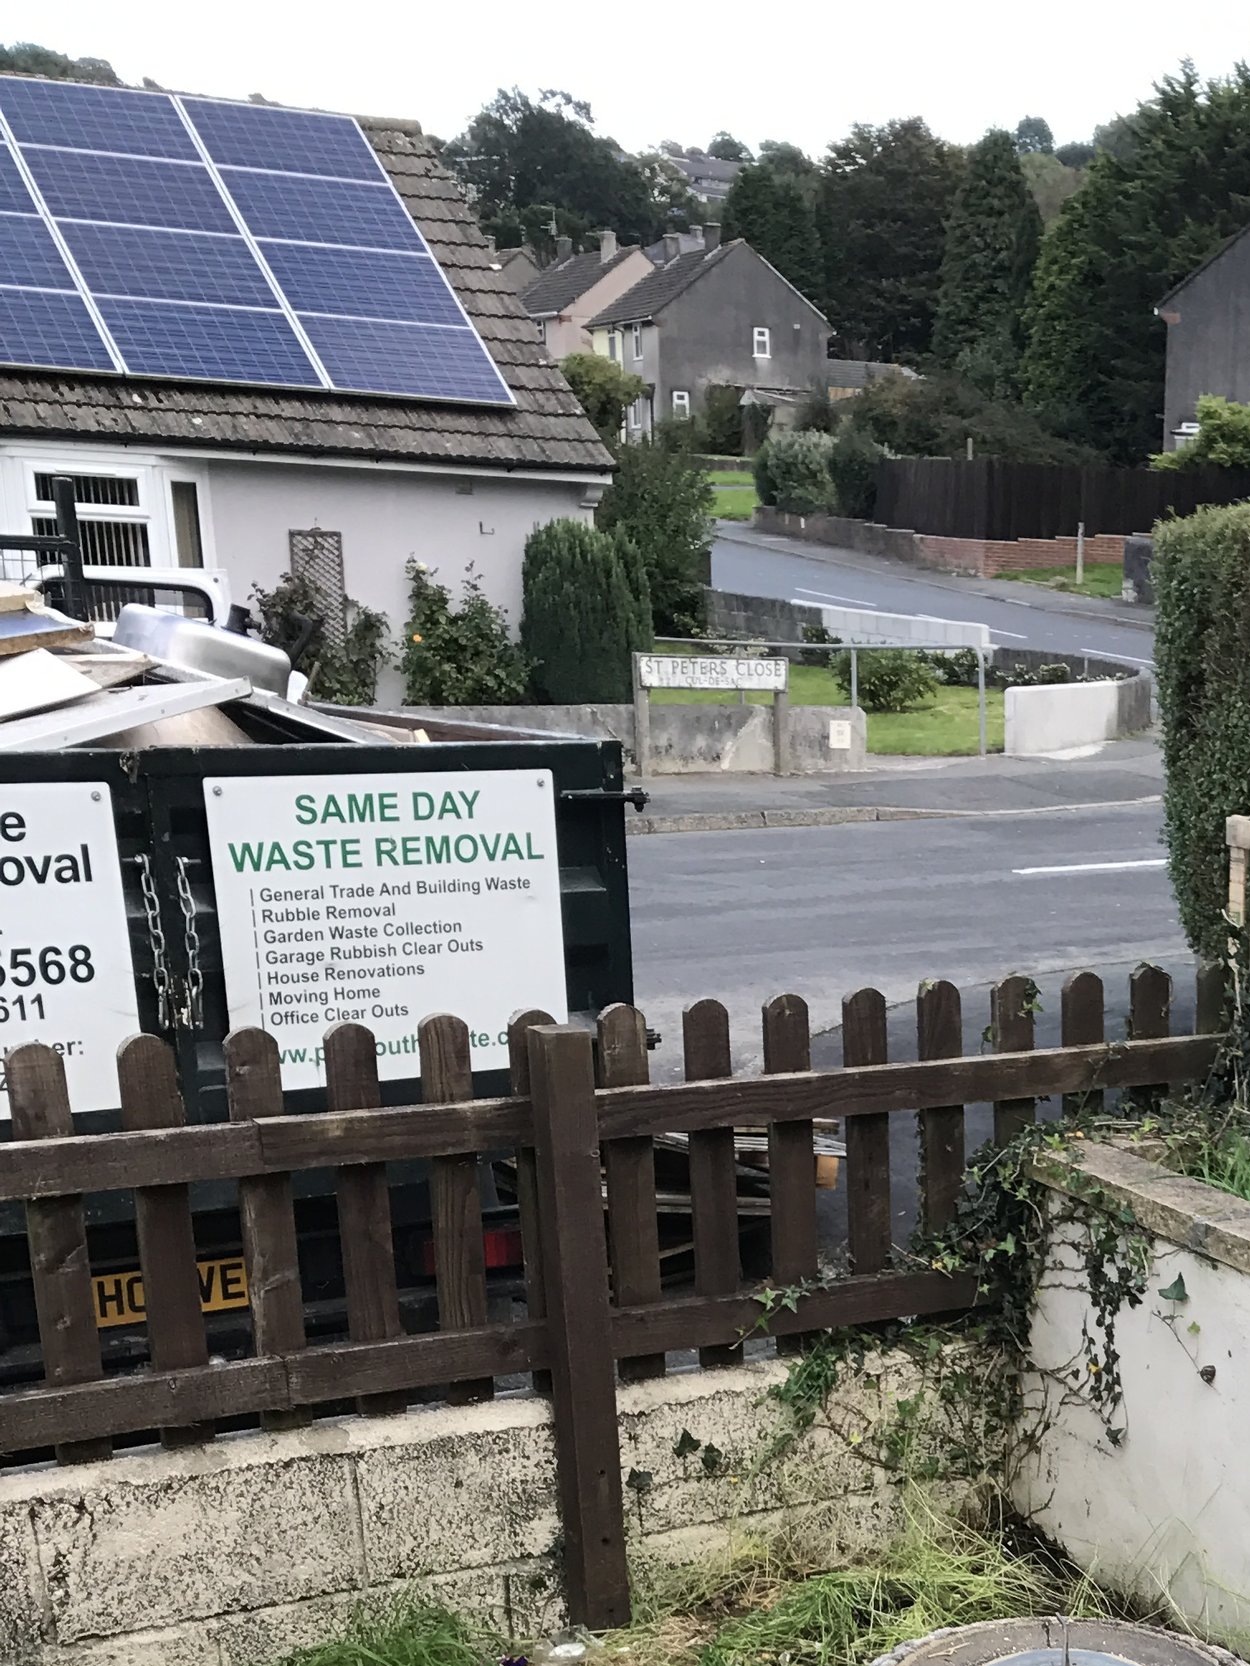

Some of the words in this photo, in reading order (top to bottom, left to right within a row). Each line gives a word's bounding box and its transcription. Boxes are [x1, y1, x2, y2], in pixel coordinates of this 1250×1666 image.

[645, 660, 663, 674] ST
[672, 660, 727, 676] PETERS
[736, 661, 782, 677] CLOSE
[295, 793, 400, 825] SAME
[412, 790, 480, 820] DAY
[228, 838, 363, 873] WASTE
[375, 832, 544, 867] REMOVAL
[260, 885, 324, 902] General
[329, 883, 375, 899] Trade
[379, 881, 411, 896] And
[416, 878, 481, 895] Building
[485, 876, 531, 891] Waste
[262, 907, 320, 923] Rubble
[326, 902, 396, 920] Removal
[264, 928, 324, 944] Garden
[329, 925, 378, 940] Waste
[383, 920, 462, 937] Collection
[265, 950, 325, 966] Garage
[330, 943, 397, 960] Rubbish
[402, 941, 443, 956] Clear
[447, 939, 483, 953] Outs
[0, 944, 95, 988] 568
[267, 971, 319, 985] House
[324, 963, 425, 982] Renovations
[269, 989, 328, 1006] Moving
[334, 986, 380, 1001] Home
[270, 1011, 319, 1026] Office
[324, 1007, 366, 1022] Clear
[371, 1004, 409, 1018] Outs
